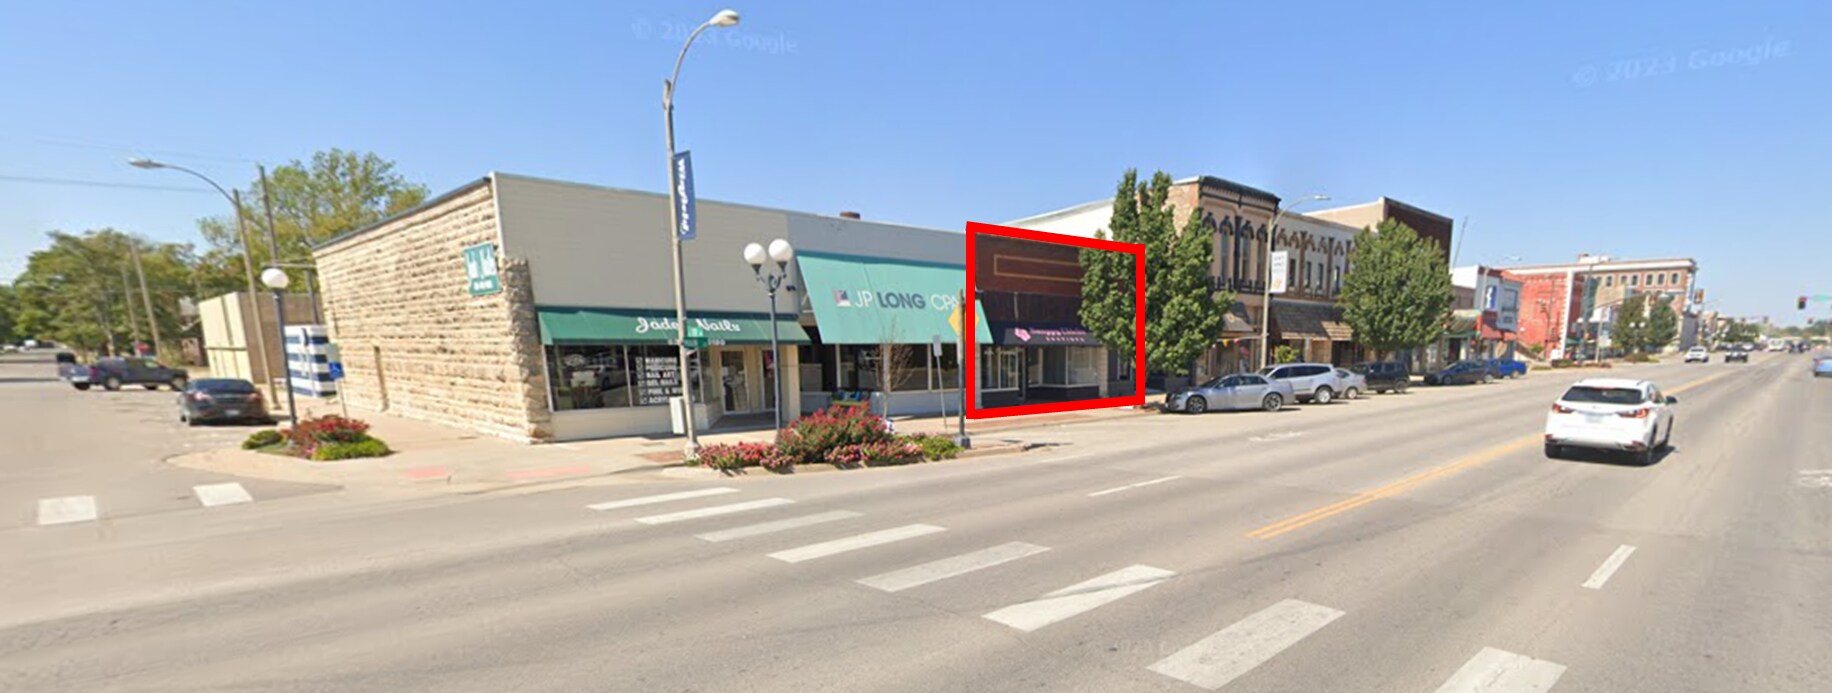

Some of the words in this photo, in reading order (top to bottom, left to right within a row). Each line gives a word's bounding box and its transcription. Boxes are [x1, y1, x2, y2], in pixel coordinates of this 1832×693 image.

[855, 288, 873, 308] JP
[876, 291, 926, 309] LONG
[695, 318, 741, 332] Nails
